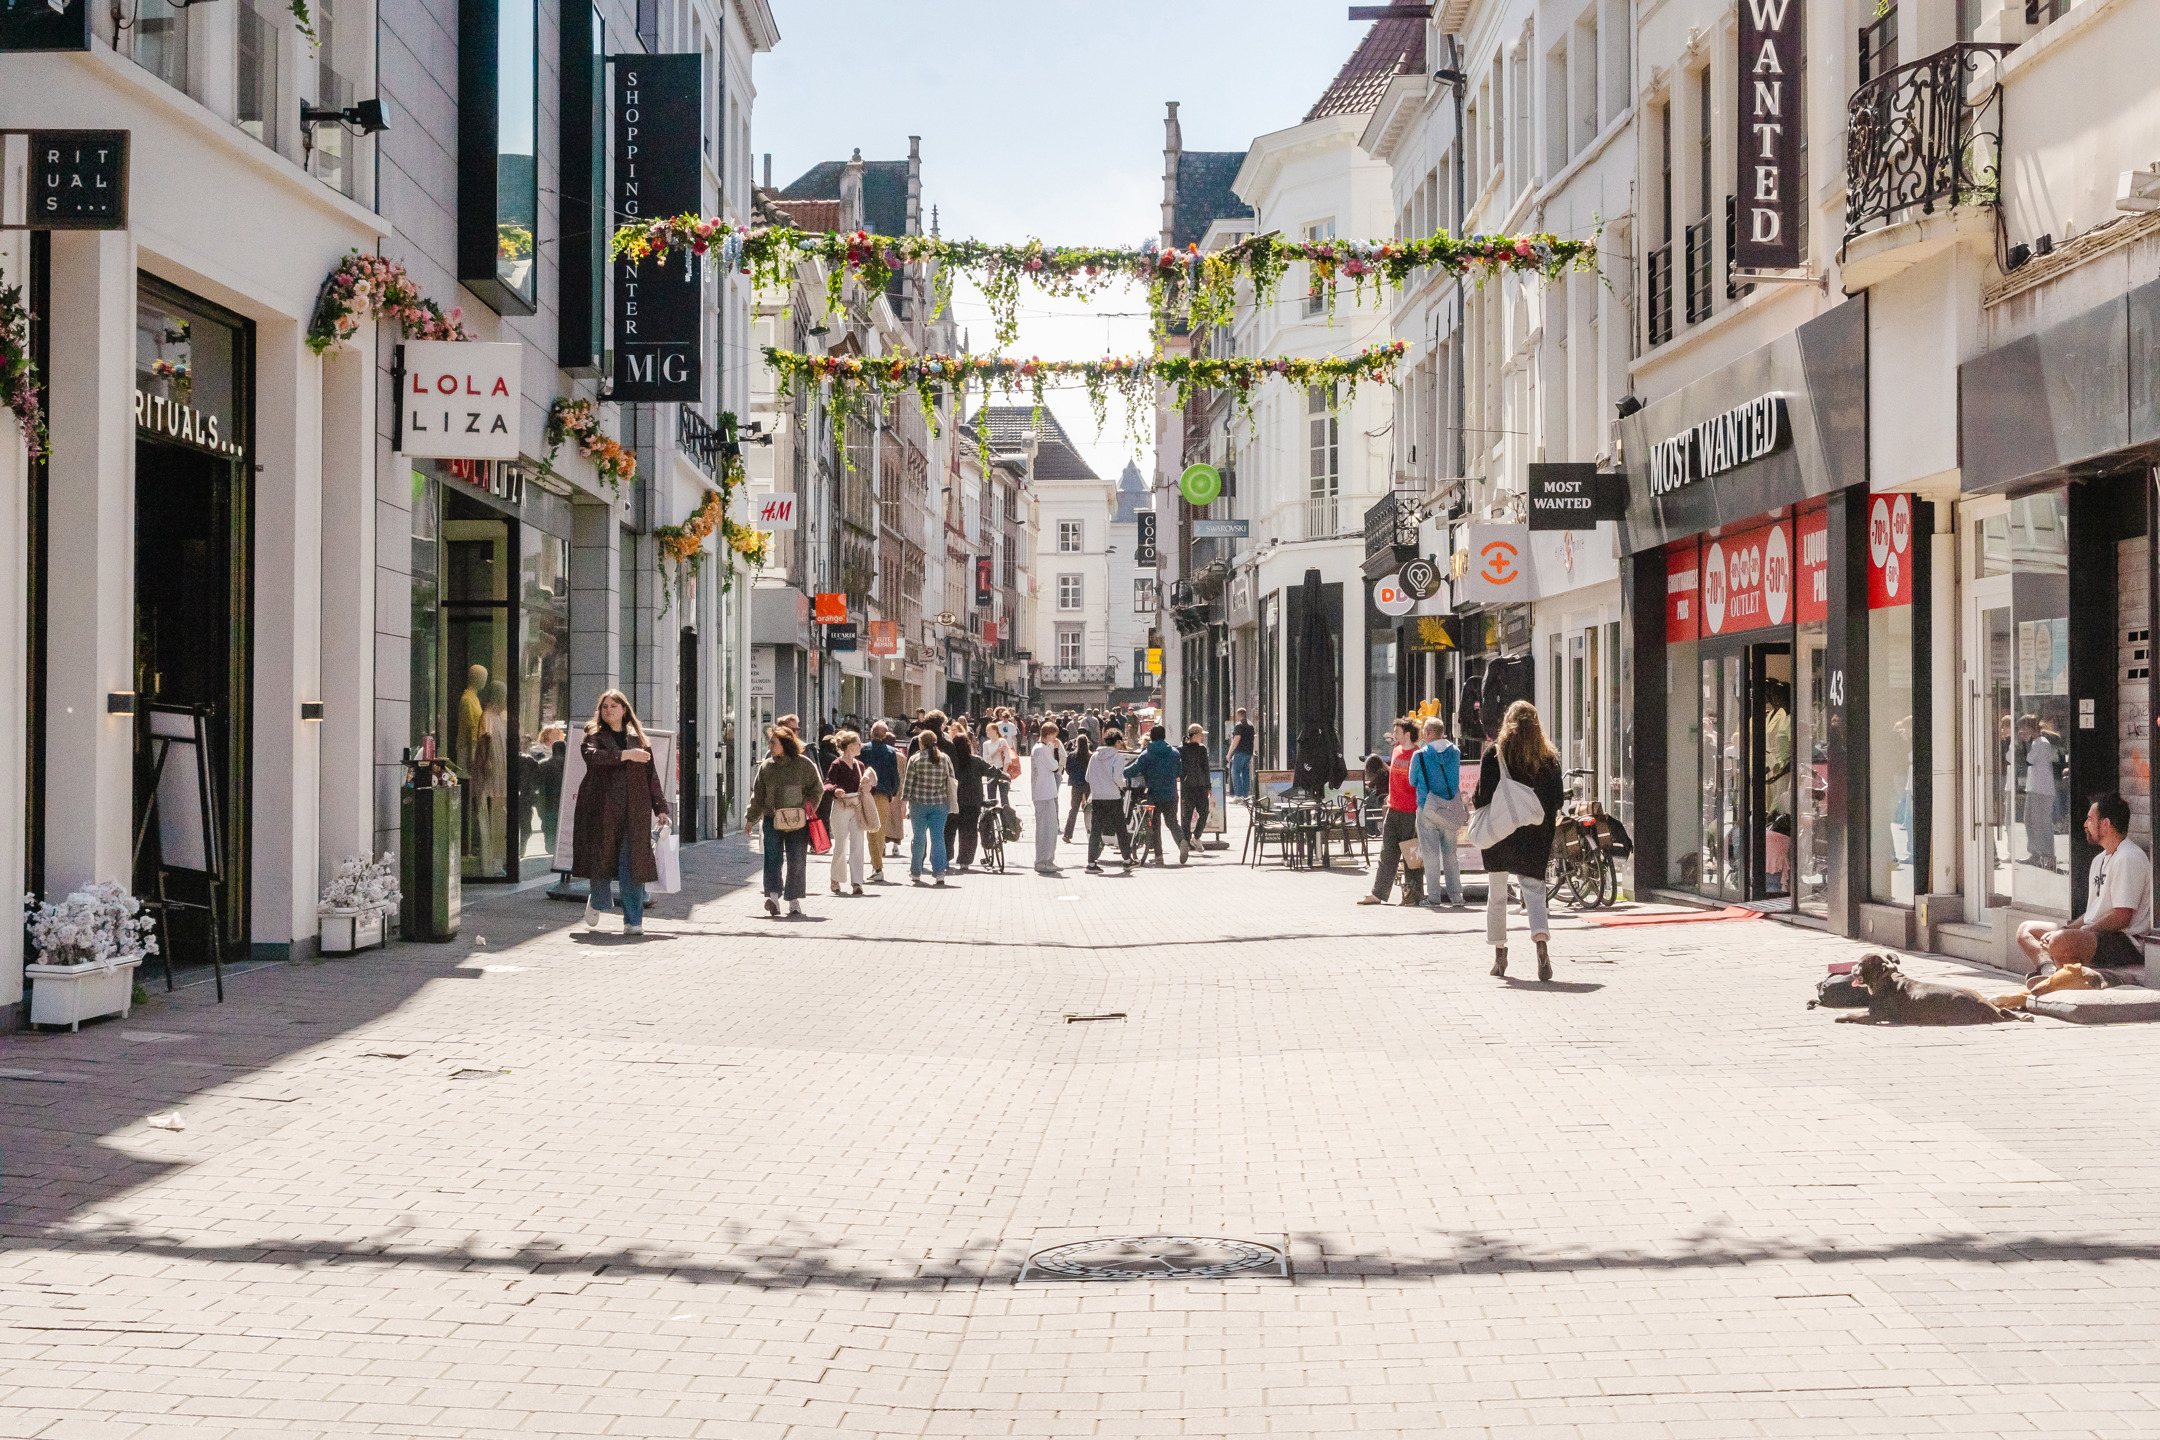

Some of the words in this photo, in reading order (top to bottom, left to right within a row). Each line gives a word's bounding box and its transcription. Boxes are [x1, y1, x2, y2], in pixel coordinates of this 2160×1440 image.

[1749, 0, 1789, 243] WANTED
[47, 149, 109, 163] RIT
[625, 72, 640, 215] SHOPPING
[47, 174, 107, 188] UAL
[413, 373, 509, 397] LOLA
[412, 411, 508, 434] LIZA
[1650, 428, 1693, 498] MOST
[1698, 392, 1778, 479] WANTED
[1544, 481, 1582, 493] MOST
[760, 500, 792, 522] H&M
[1533, 498, 1592, 509] WANTED
[1144, 515, 1155, 558] COCO
[1206, 524, 1247, 533] SWAROVSKI
[1872, 519, 1889, 546] -70%
[1766, 556, 1789, 594] -50%
[1706, 571, 1725, 605] -70%
[1730, 590, 1760, 618] OUTLET
[817, 613, 844, 623] orange
[1829, 670, 1844, 706] 43
